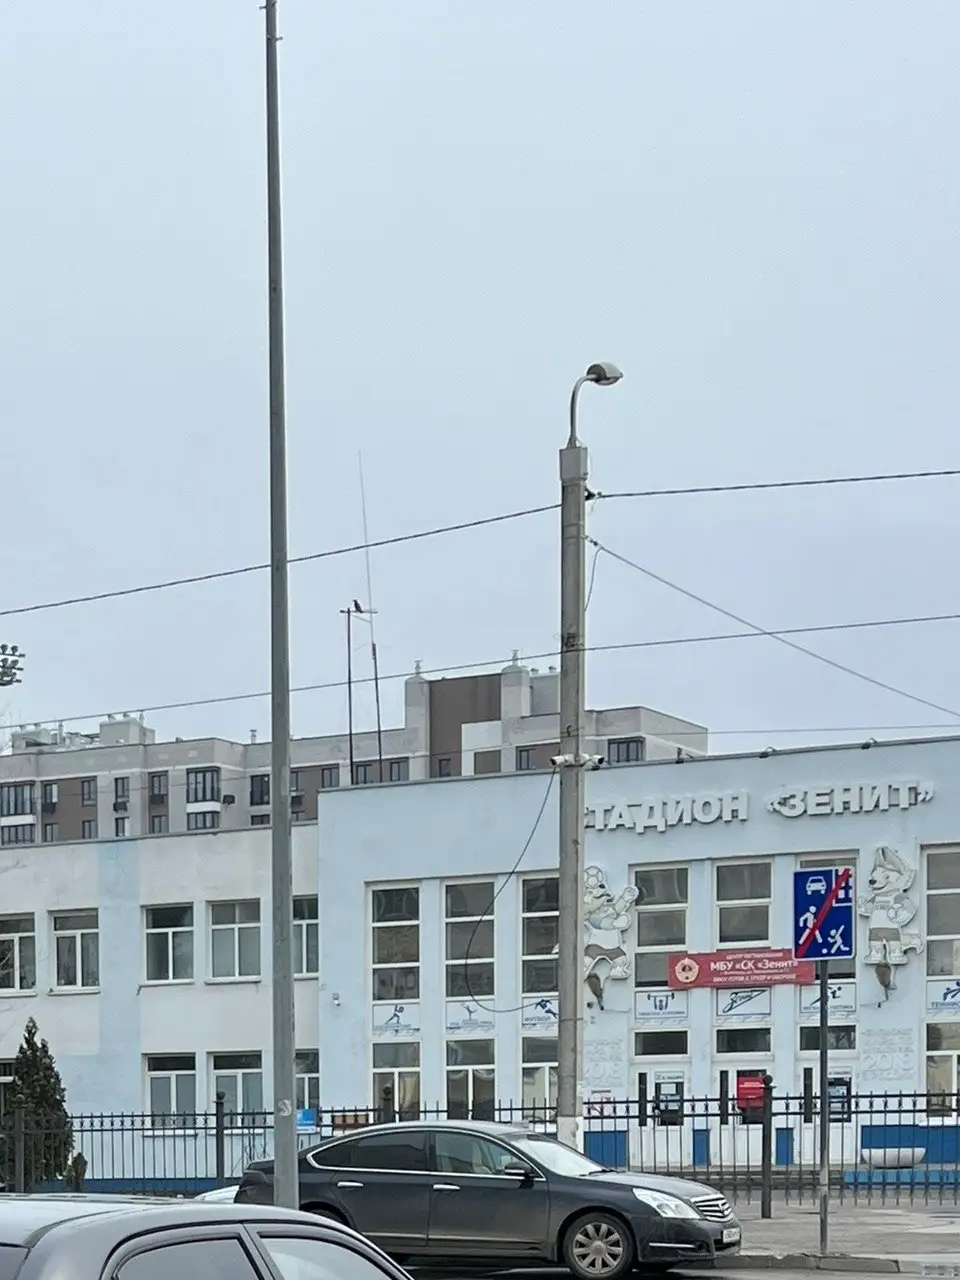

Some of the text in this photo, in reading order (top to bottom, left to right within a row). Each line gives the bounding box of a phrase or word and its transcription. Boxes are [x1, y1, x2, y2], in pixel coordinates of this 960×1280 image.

[768, 779, 934, 817] «ЗЕНИТ»
[710, 960, 734, 972] МБУ
[736, 958, 755, 970] «СК
